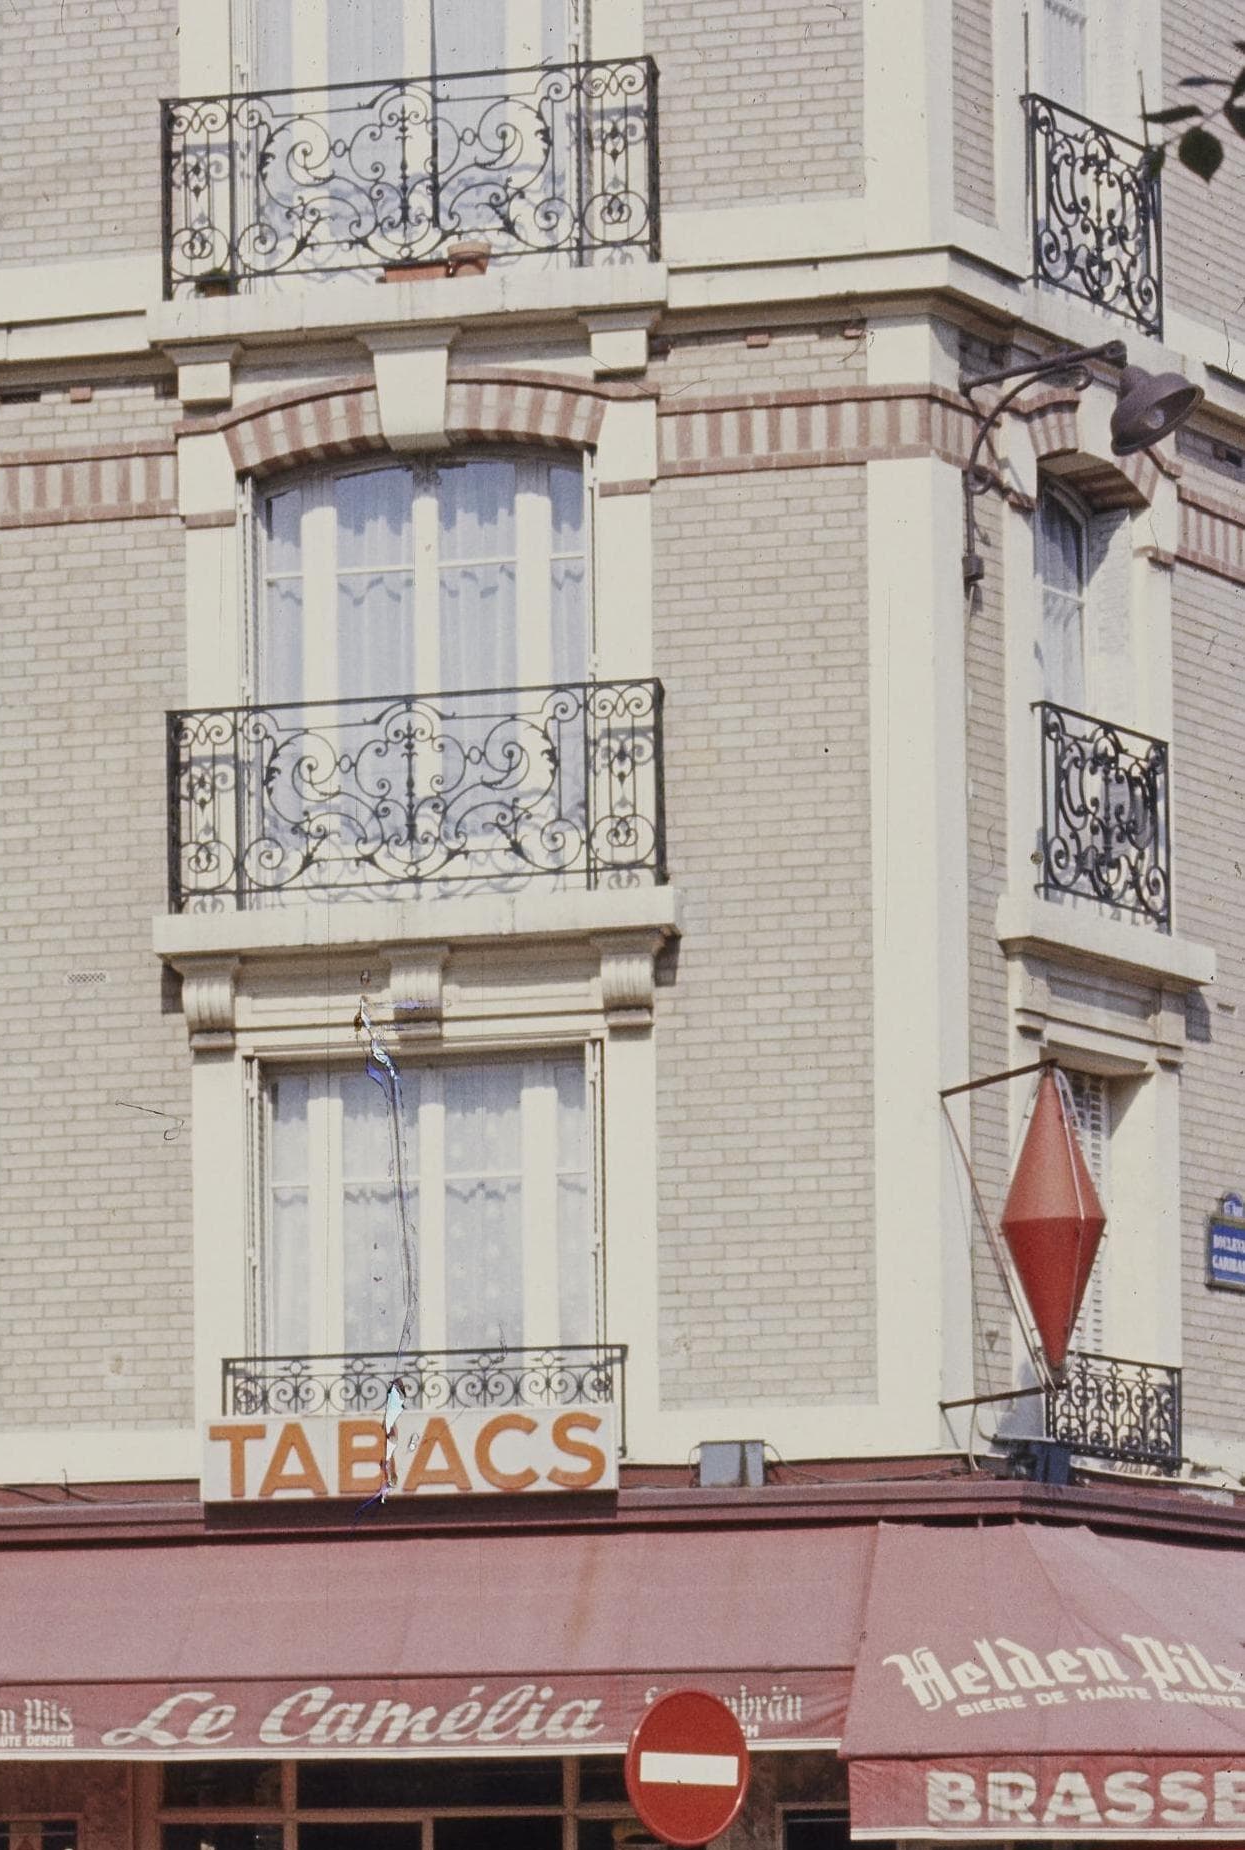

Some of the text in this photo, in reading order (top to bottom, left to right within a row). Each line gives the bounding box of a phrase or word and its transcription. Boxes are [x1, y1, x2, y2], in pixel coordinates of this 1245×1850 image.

[208, 1411, 607, 1498] TABACS
[882, 1637, 1130, 1711] Helden
[1035, 1689, 1070, 1707] DE
[1076, 1685, 1153, 1703] HAUTE
[24, 1698, 74, 1735] Pils
[101, 1684, 605, 1747] Le Camélia
[926, 1770, 1245, 1824] BRASSE
